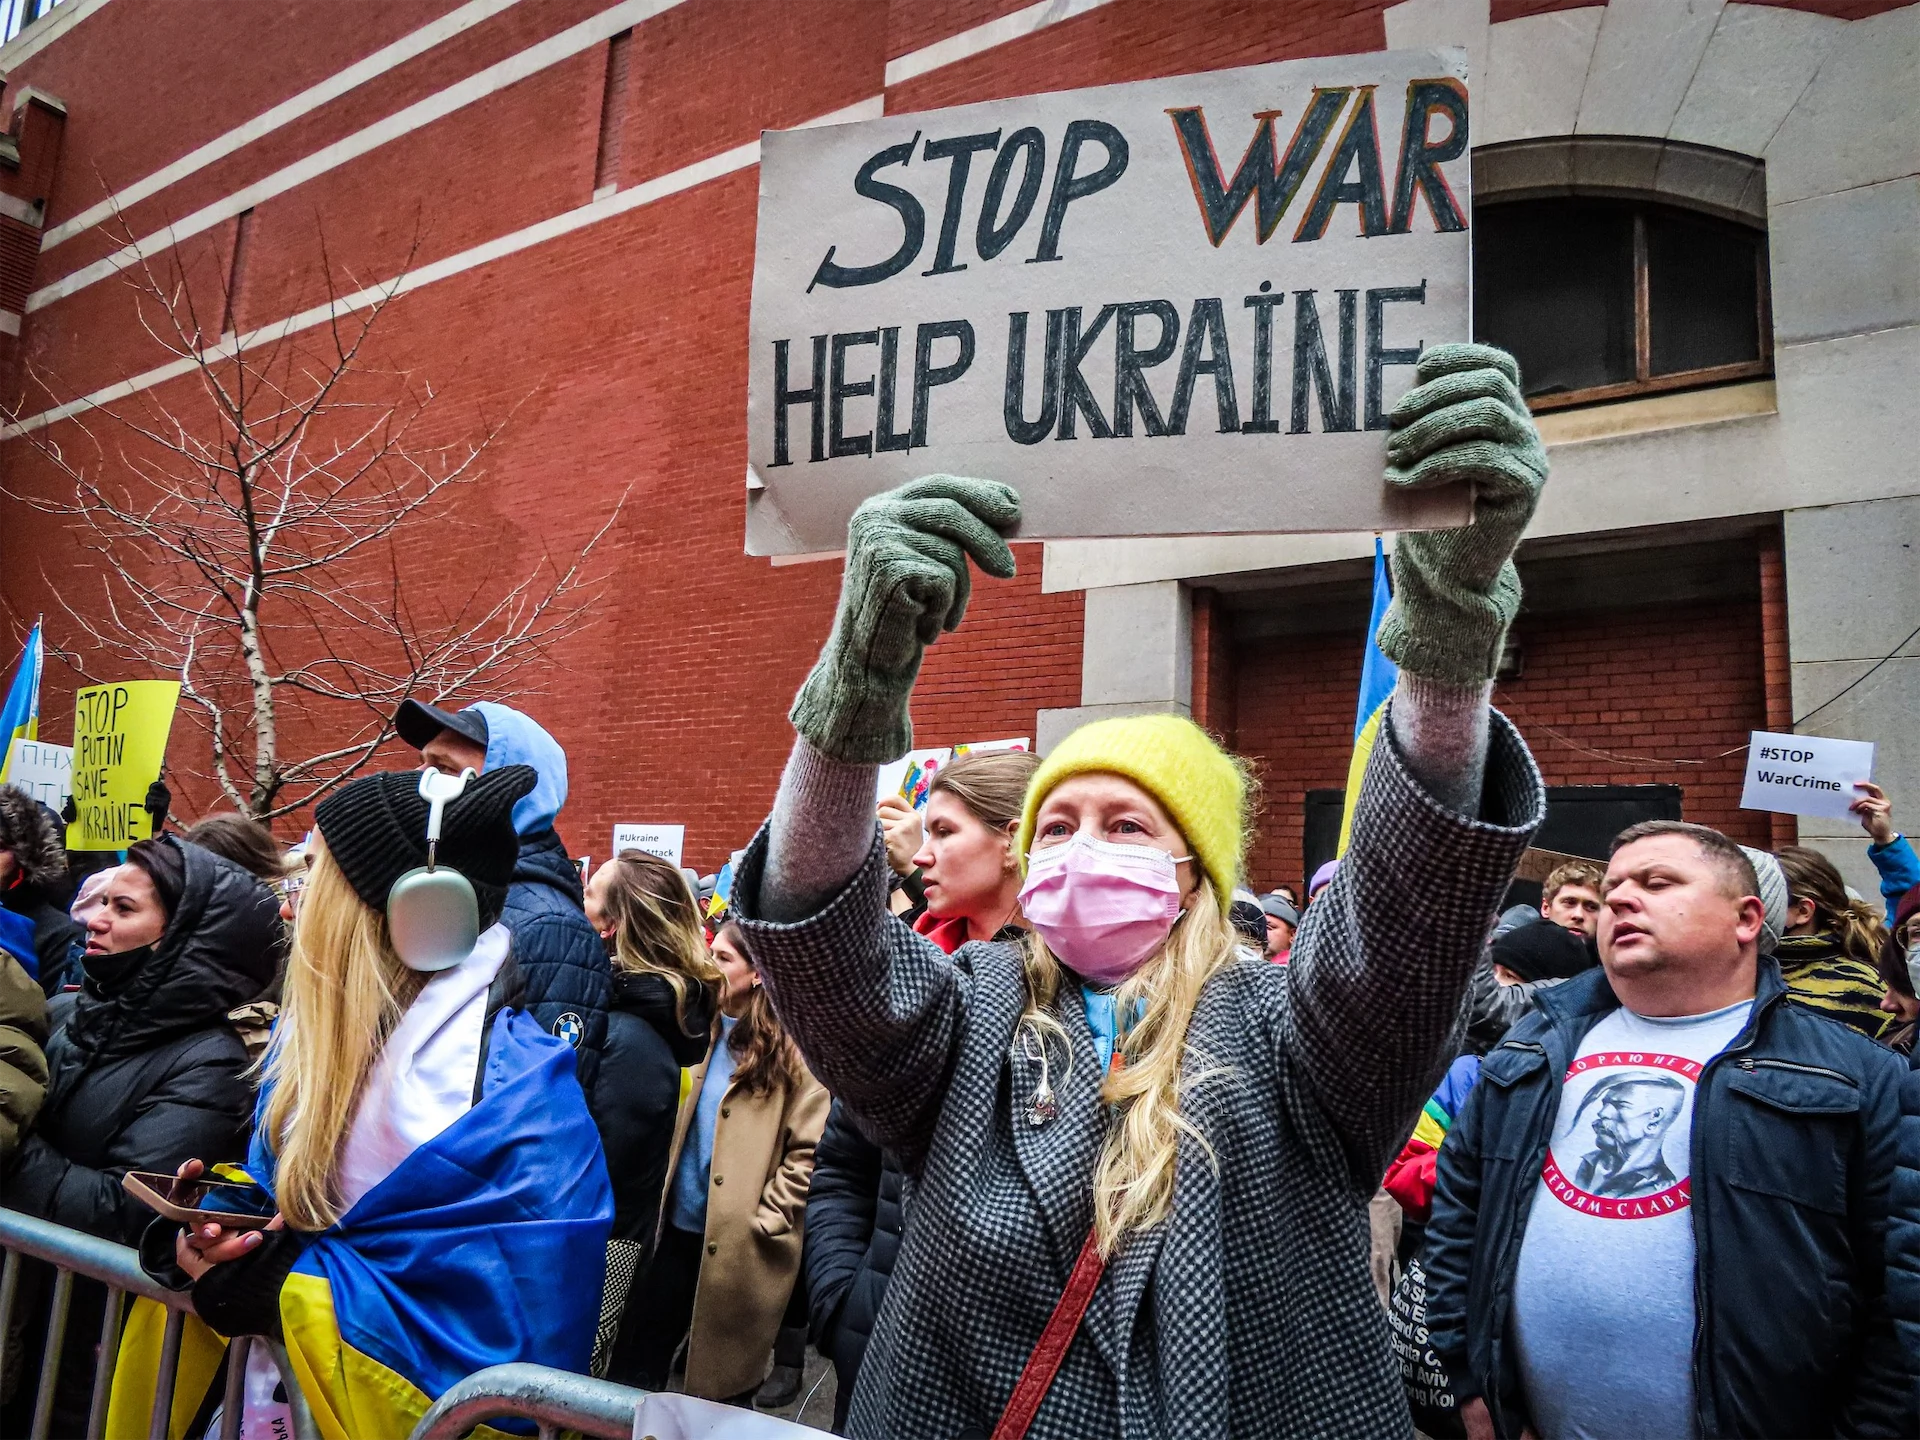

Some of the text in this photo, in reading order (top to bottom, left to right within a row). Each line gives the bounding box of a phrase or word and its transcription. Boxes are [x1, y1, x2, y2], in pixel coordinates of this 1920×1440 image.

[807, 77, 1469, 295] STOP WAR
[767, 318, 975, 467] HELP
[76, 687, 128, 733] STOP
[82, 732, 125, 768] PUTIN
[1760, 747, 1814, 763] #STOP
[76, 768, 108, 801] SAVE
[1757, 770, 1841, 792] WarCrime
[620, 833, 659, 842] #Ukraine
[1598, 1054, 1644, 1065] РАЮ
